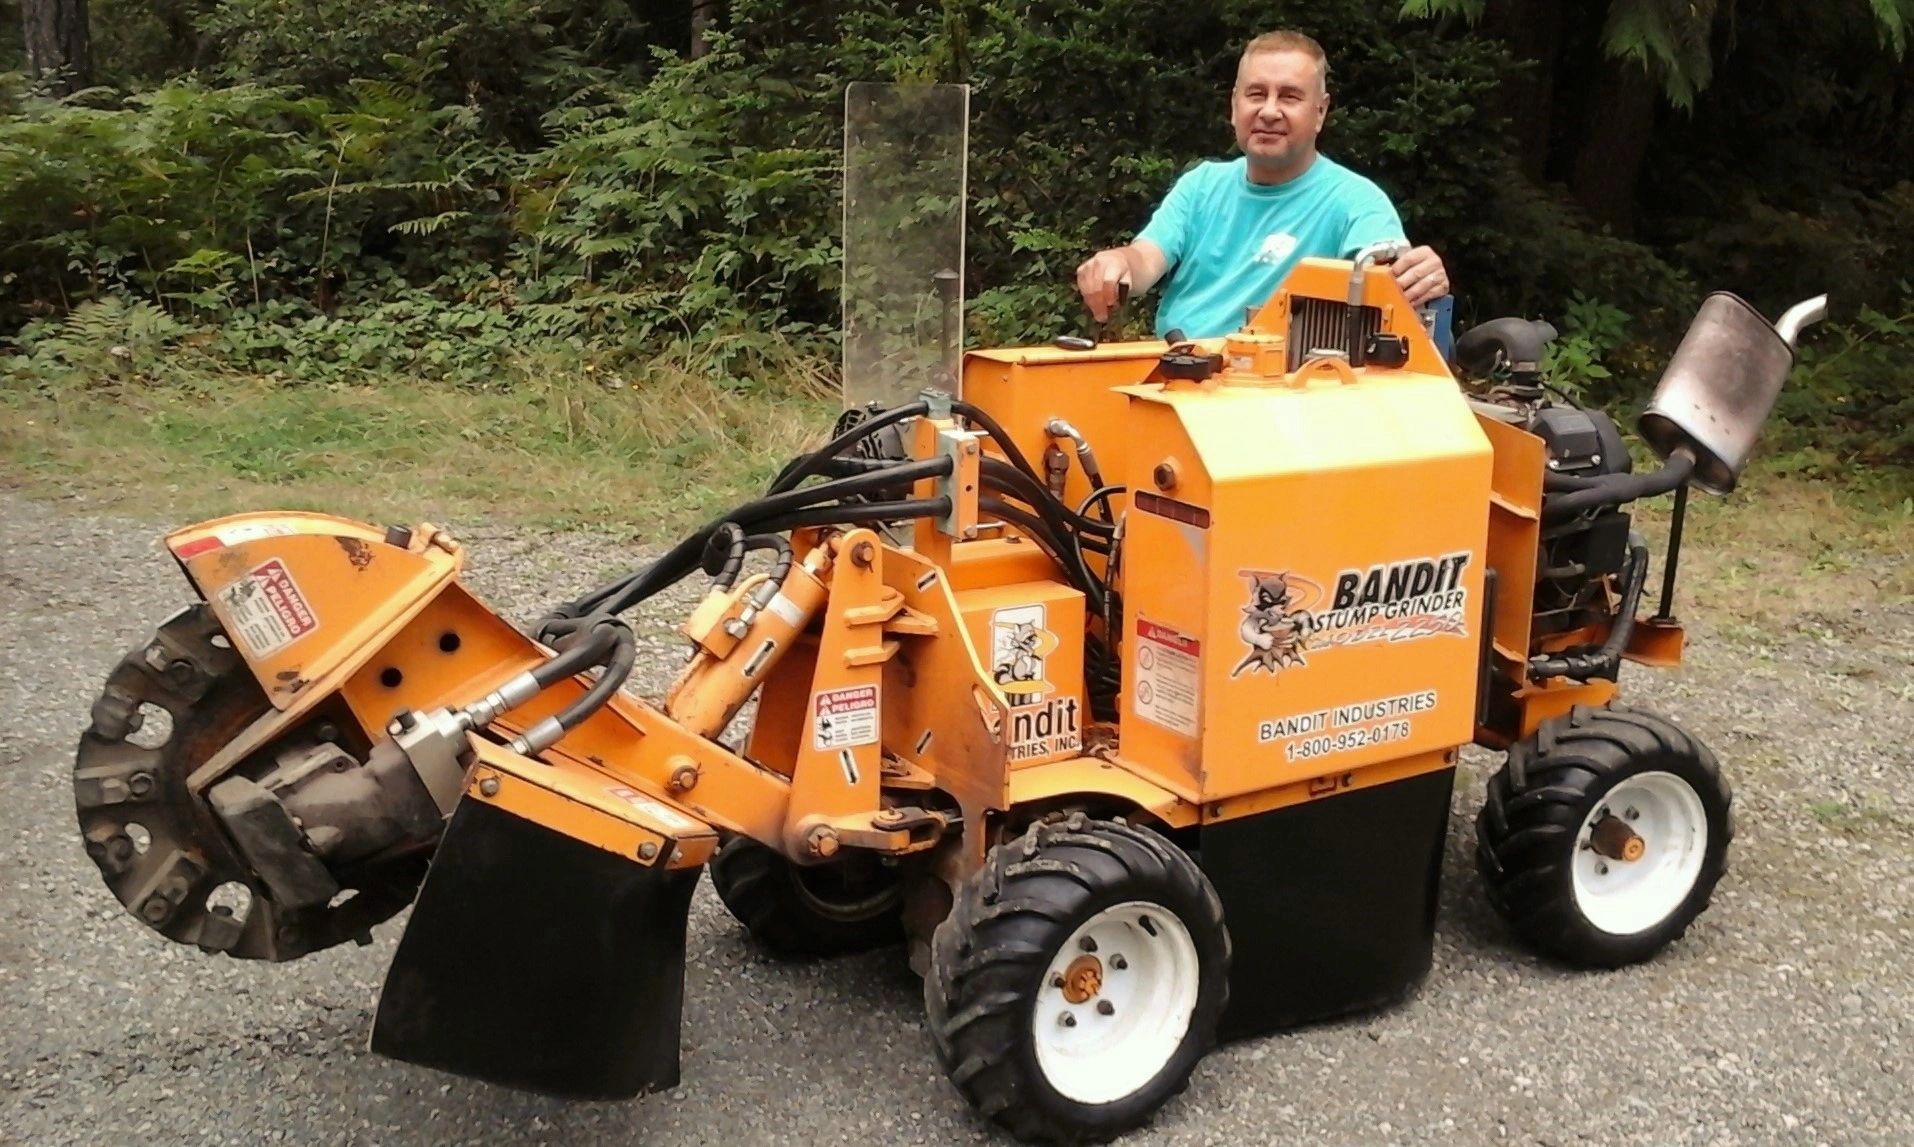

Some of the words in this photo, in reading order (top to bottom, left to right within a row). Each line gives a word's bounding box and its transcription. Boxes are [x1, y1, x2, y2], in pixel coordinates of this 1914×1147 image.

[279, 580, 312, 627] DANGER
[1332, 553, 1469, 611] BANDIT
[266, 585, 301, 634] PELIGRO
[1313, 606, 1380, 634] STUMP
[1384, 592, 1465, 619] GRINDER
[831, 688, 873, 702] DANGER
[831, 698, 875, 713] PELIGRO
[1260, 712, 1327, 741] BANDIT
[1333, 692, 1436, 727] INDUSTRIES
[1013, 698, 1078, 743] ndit
[1287, 722, 1409, 760] 1-800-952-0178
